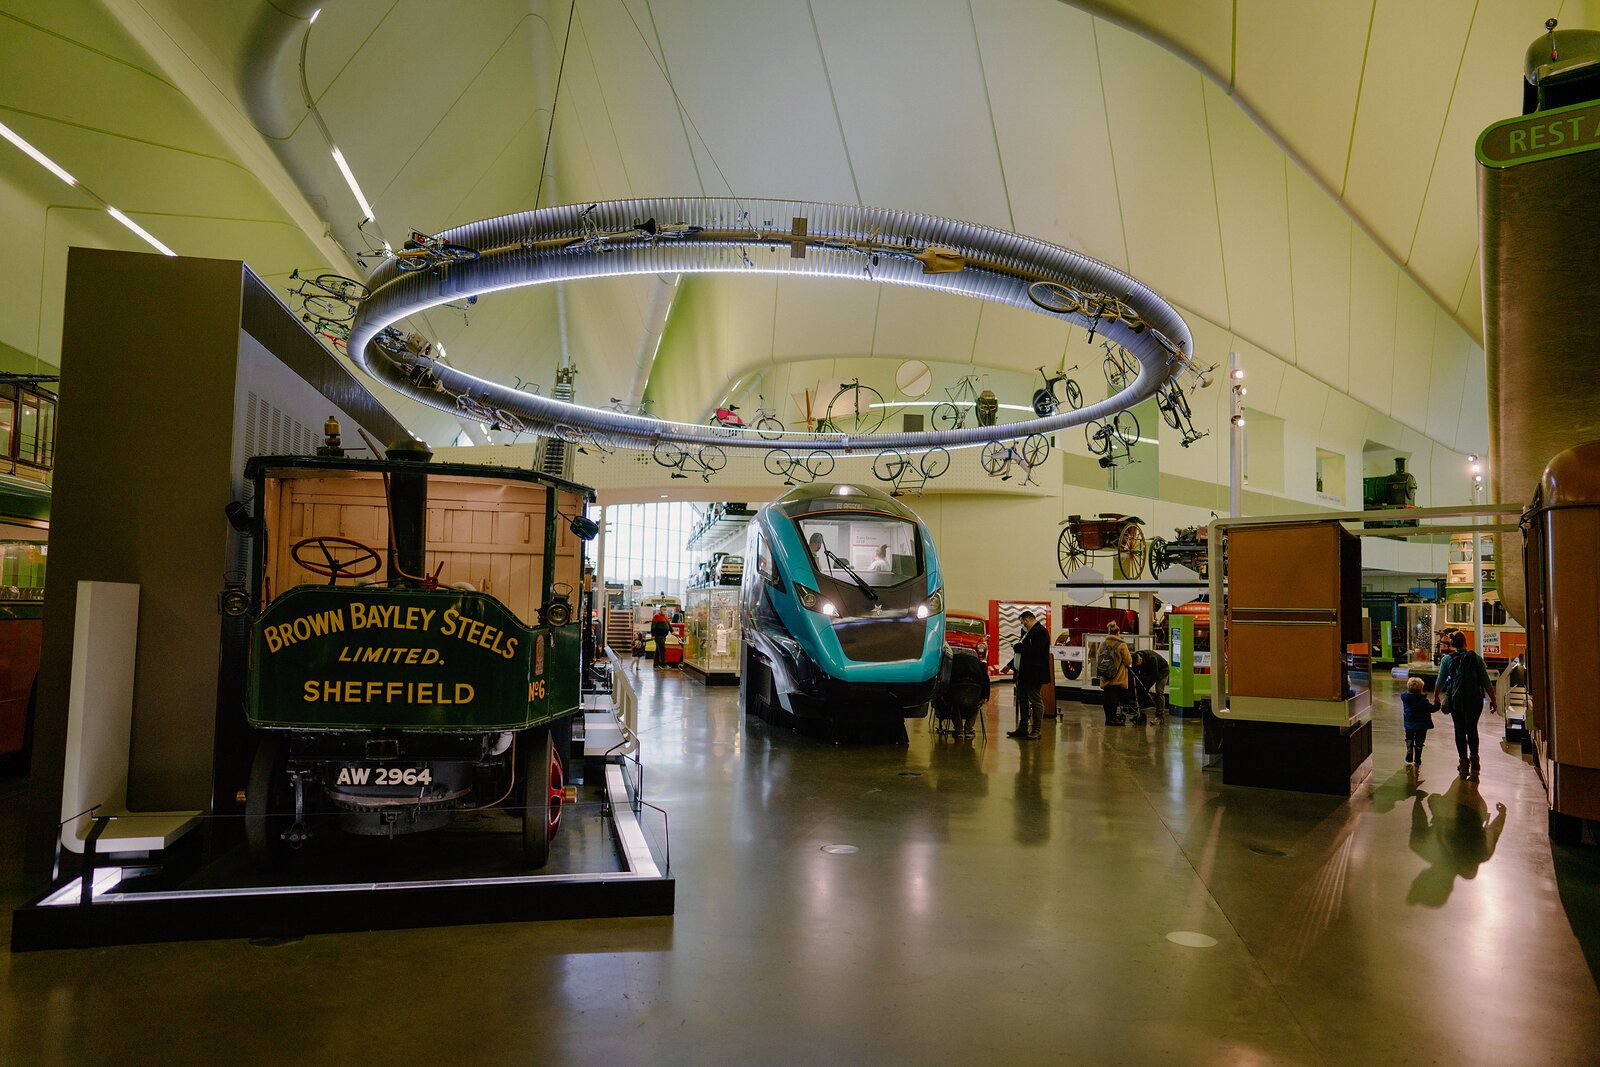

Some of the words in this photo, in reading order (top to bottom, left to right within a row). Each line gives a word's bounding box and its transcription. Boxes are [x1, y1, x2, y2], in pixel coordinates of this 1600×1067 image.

[1509, 115, 1585, 154] REST
[263, 608, 345, 654] BROWN
[349, 602, 436, 631] BAYLEY
[440, 608, 519, 660] STEELS
[338, 646, 445, 666] LIMITED.
[304, 680, 475, 704] SHEFFIELD
[336, 767, 371, 786] AW
[375, 767, 432, 786] 2964
